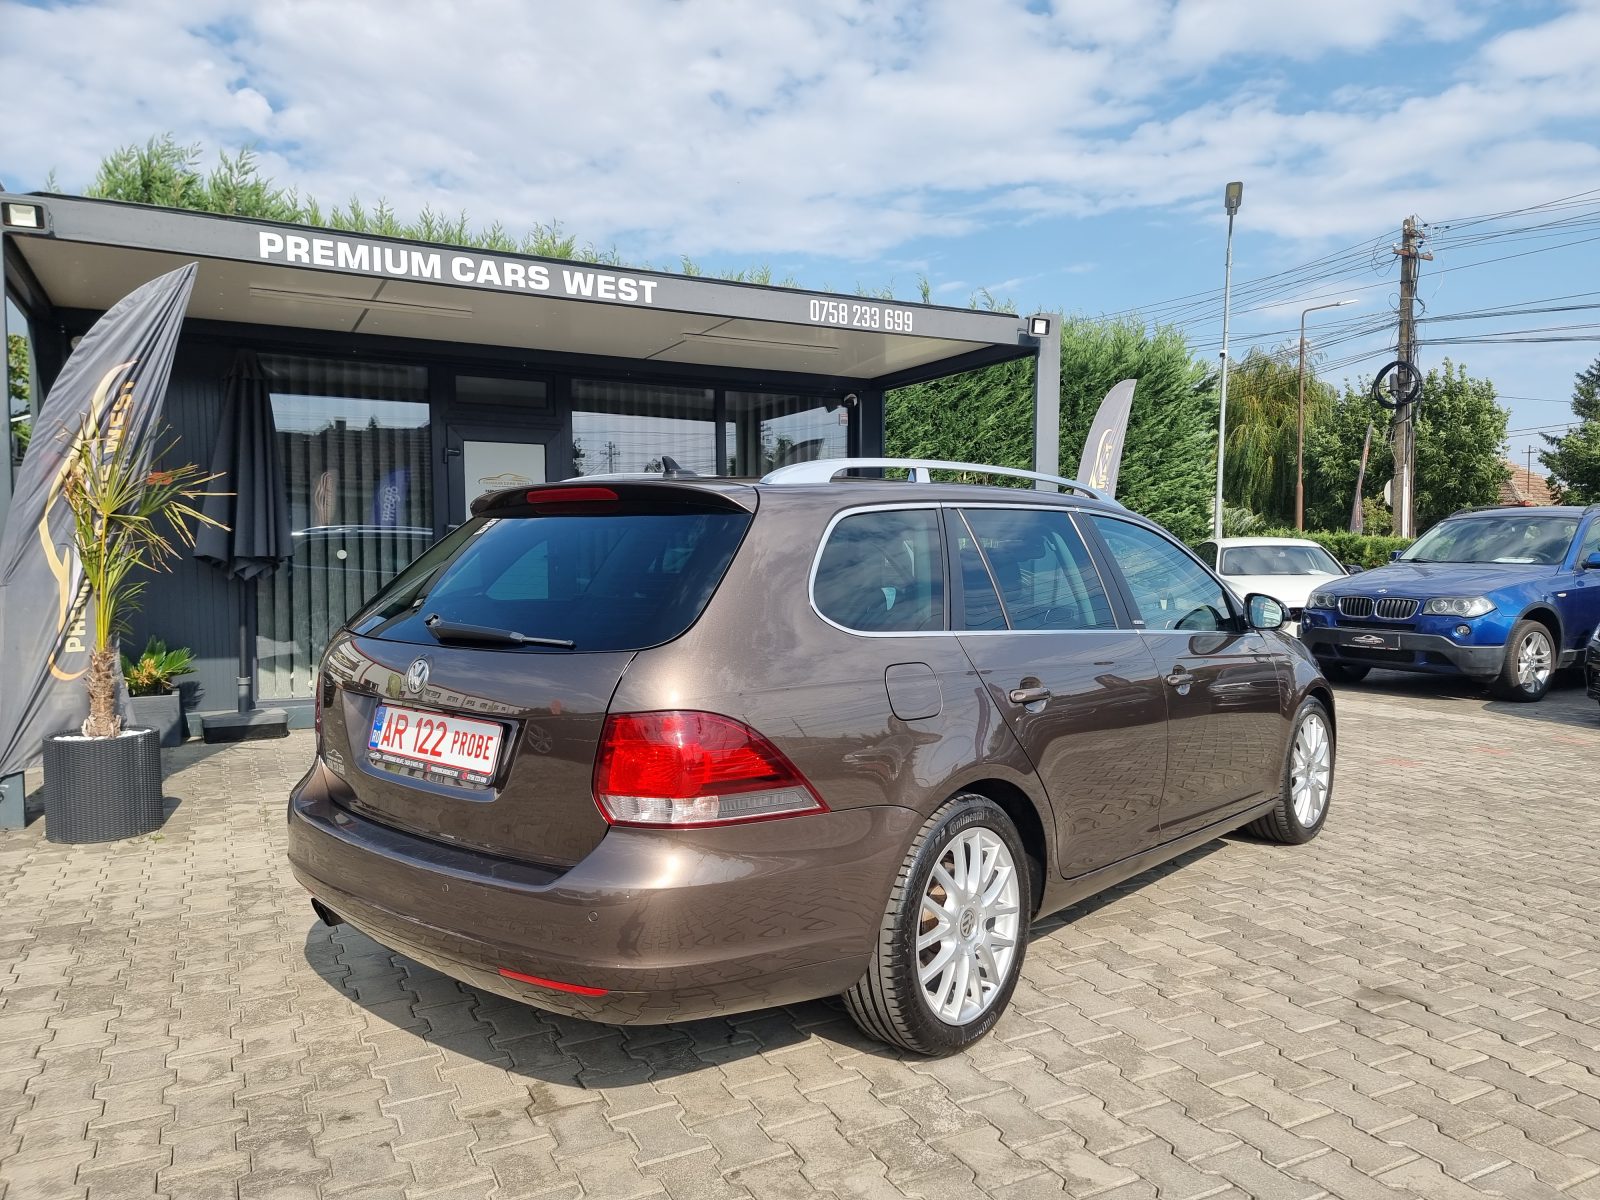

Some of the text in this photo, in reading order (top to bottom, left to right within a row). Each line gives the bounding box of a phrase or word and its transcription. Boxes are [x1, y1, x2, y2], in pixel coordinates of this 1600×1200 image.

[259, 231, 658, 304] PREMIUM CARS WEST
[809, 299, 913, 332] 0758 233 699
[380, 712, 408, 750] AR
[413, 717, 448, 758] 122
[450, 730, 493, 761] PROBE
